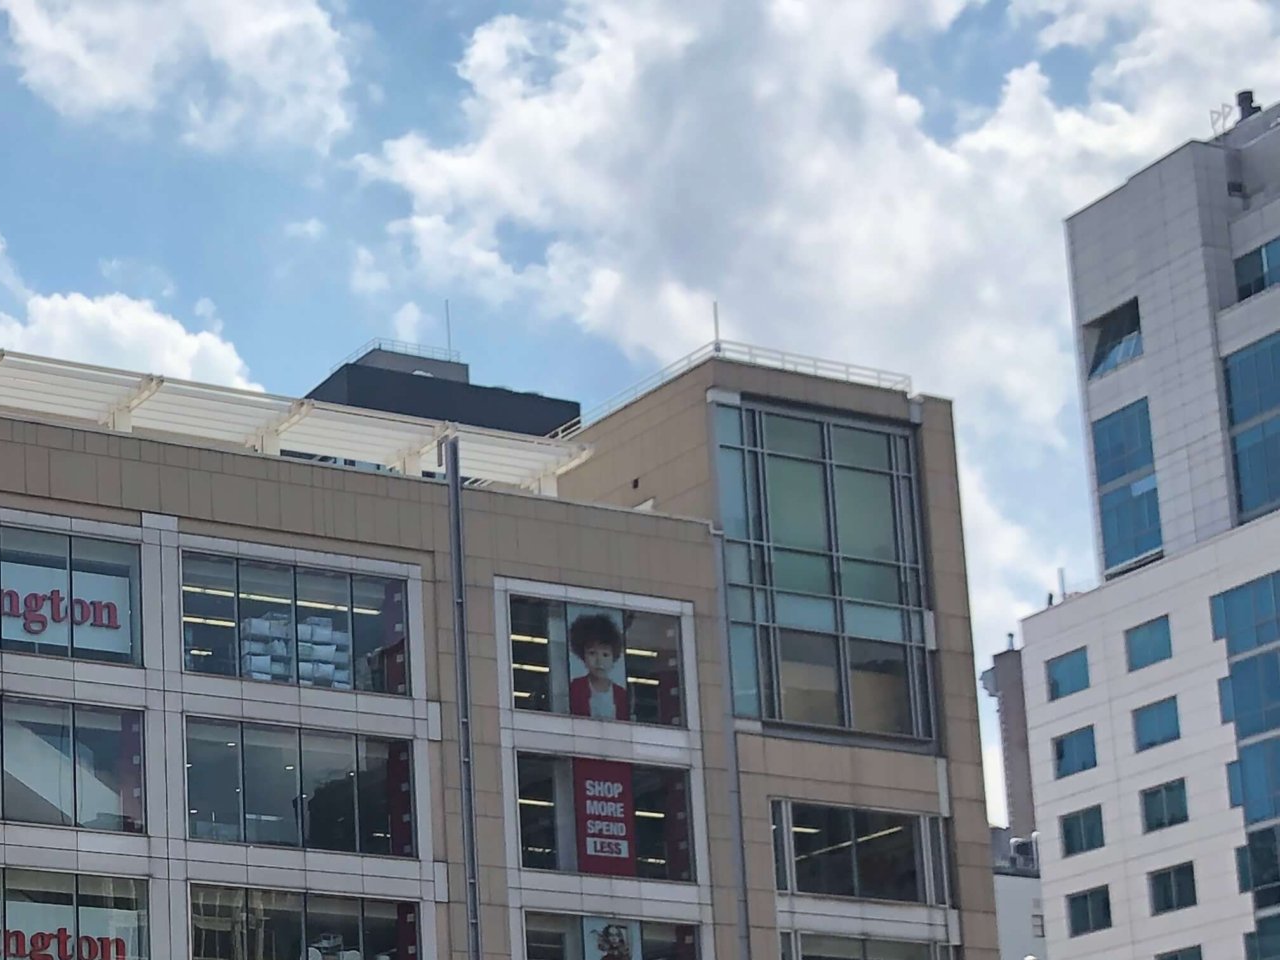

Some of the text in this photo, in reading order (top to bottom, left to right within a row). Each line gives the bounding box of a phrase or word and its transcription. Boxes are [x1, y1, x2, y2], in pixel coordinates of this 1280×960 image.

[585, 779, 623, 798] SHOP
[586, 800, 625, 817] MORE
[586, 819, 626, 836] SPEND
[592, 840, 622, 856] LESS
